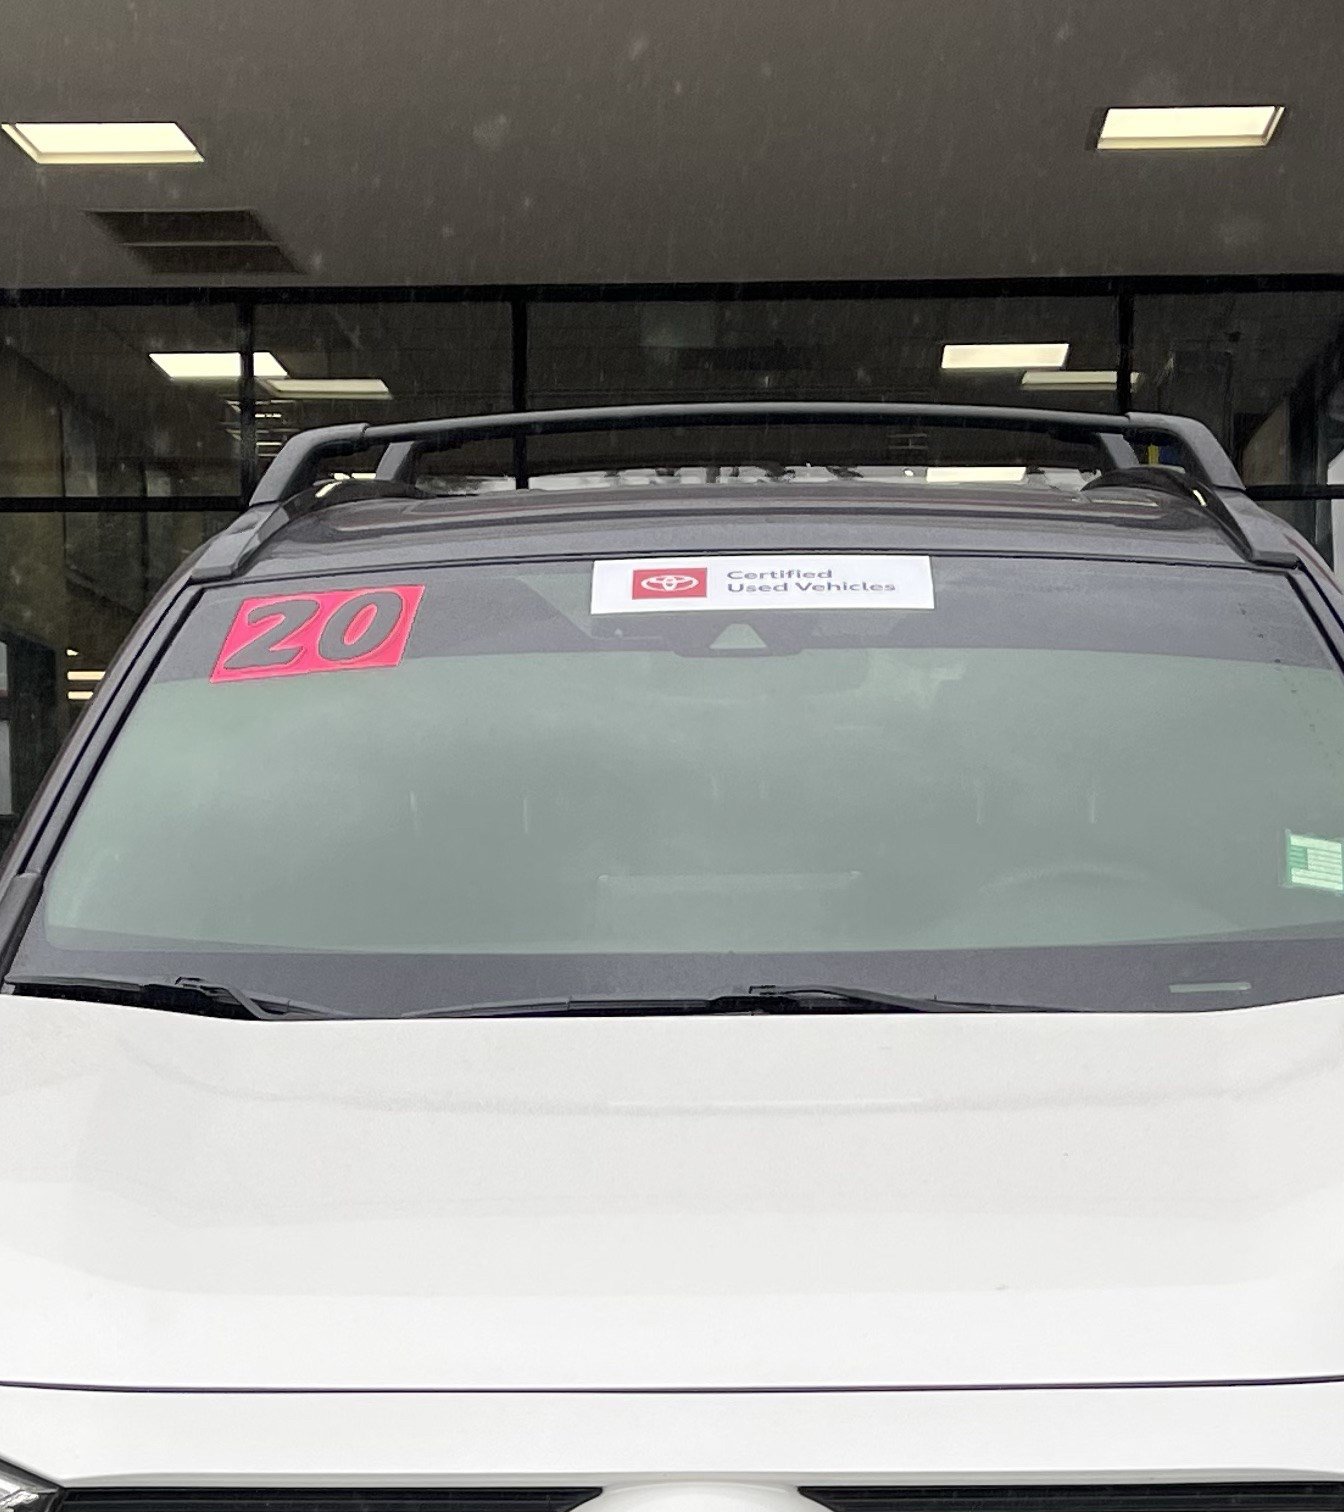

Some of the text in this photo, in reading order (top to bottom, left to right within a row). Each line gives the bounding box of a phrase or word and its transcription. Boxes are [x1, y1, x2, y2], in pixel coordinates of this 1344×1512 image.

[727, 569, 833, 580] Certified
[727, 581, 897, 592] Used Vehicles
[223, 591, 403, 670] 20
